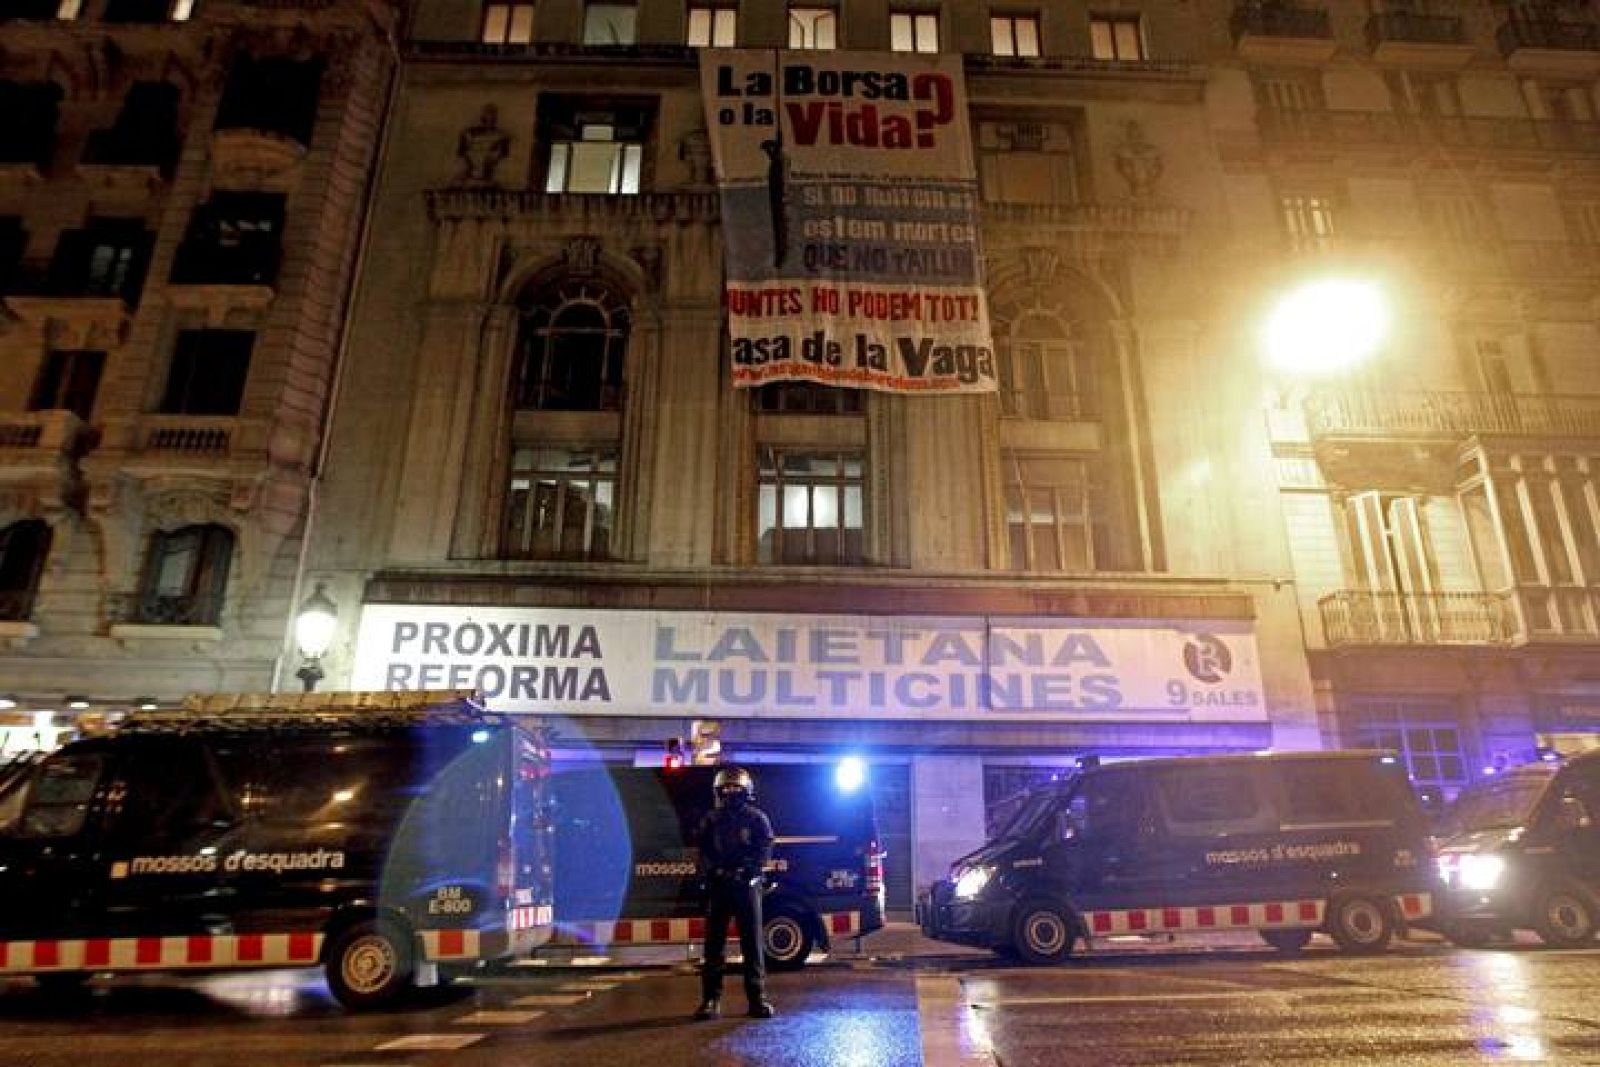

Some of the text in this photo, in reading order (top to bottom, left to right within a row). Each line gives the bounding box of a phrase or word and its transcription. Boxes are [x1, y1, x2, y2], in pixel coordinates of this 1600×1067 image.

[718, 65, 908, 100] La Borsa
[719, 108, 735, 125] o
[743, 102, 774, 125] la
[803, 243, 848, 273] QUE
[727, 288, 802, 317] UNTES
[848, 291, 921, 321] PODEM
[925, 294, 979, 323] TOT!
[802, 331, 842, 366] de
[855, 334, 888, 371] la
[897, 337, 995, 384] Vaga
[653, 626, 1111, 669] LAIETANA
[651, 668, 1123, 713] MULTICINES
[1167, 679, 1259, 706] 9 SALES
[132, 850, 346, 875] mossos d'esquadra
[635, 861, 696, 876] mossos
